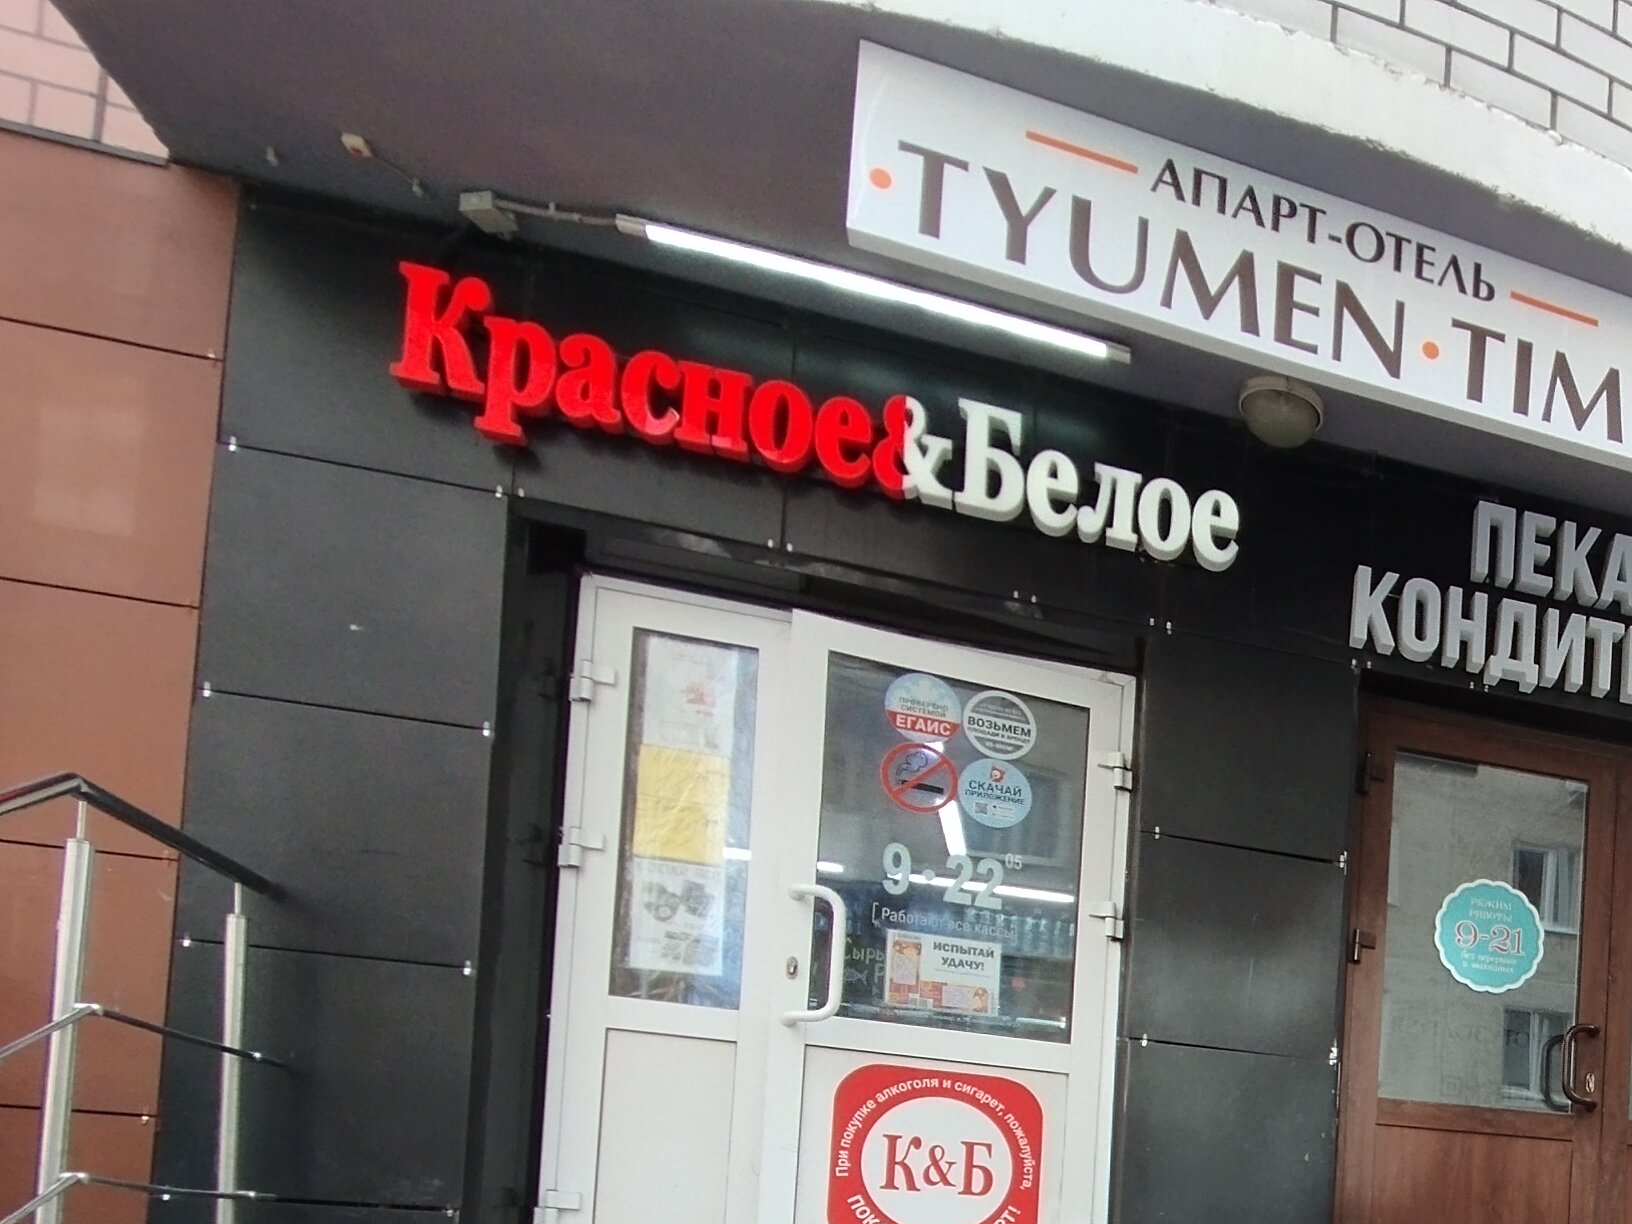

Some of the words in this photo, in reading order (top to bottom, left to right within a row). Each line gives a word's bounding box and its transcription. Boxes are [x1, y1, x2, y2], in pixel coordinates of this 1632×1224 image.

[1150, 158, 1496, 302] АПАРТ-ОТЕЛЬ
[897, 139, 1406, 381] TYUMEN
[900, 704, 947, 718] СИСТЕМОЙ
[895, 714, 951, 736] ЕГАИС
[967, 715, 1032, 738] ВОЗЬМЕМ
[965, 789, 1025, 805] ПРИЛОЖЕНИЕ
[968, 780, 1023, 798] СКАЧАЙ
[881, 907, 945, 928] Работают
[949, 919, 970, 932] все
[933, 941, 995, 959] ИСПЫТАЙ
[1455, 920, 1526, 956] 9-21
[940, 956, 985, 971] УДАЧУ!
[875, 1078, 939, 1104] алкоголя
[943, 1079, 951, 1088] и
[954, 1081, 1006, 1116] сигарет,
[840, 1100, 877, 1147] покупке
[835, 1148, 851, 1177] При
[1004, 1112, 1037, 1191] пожалуйста,
[879, 1133, 994, 1197] К&Б
